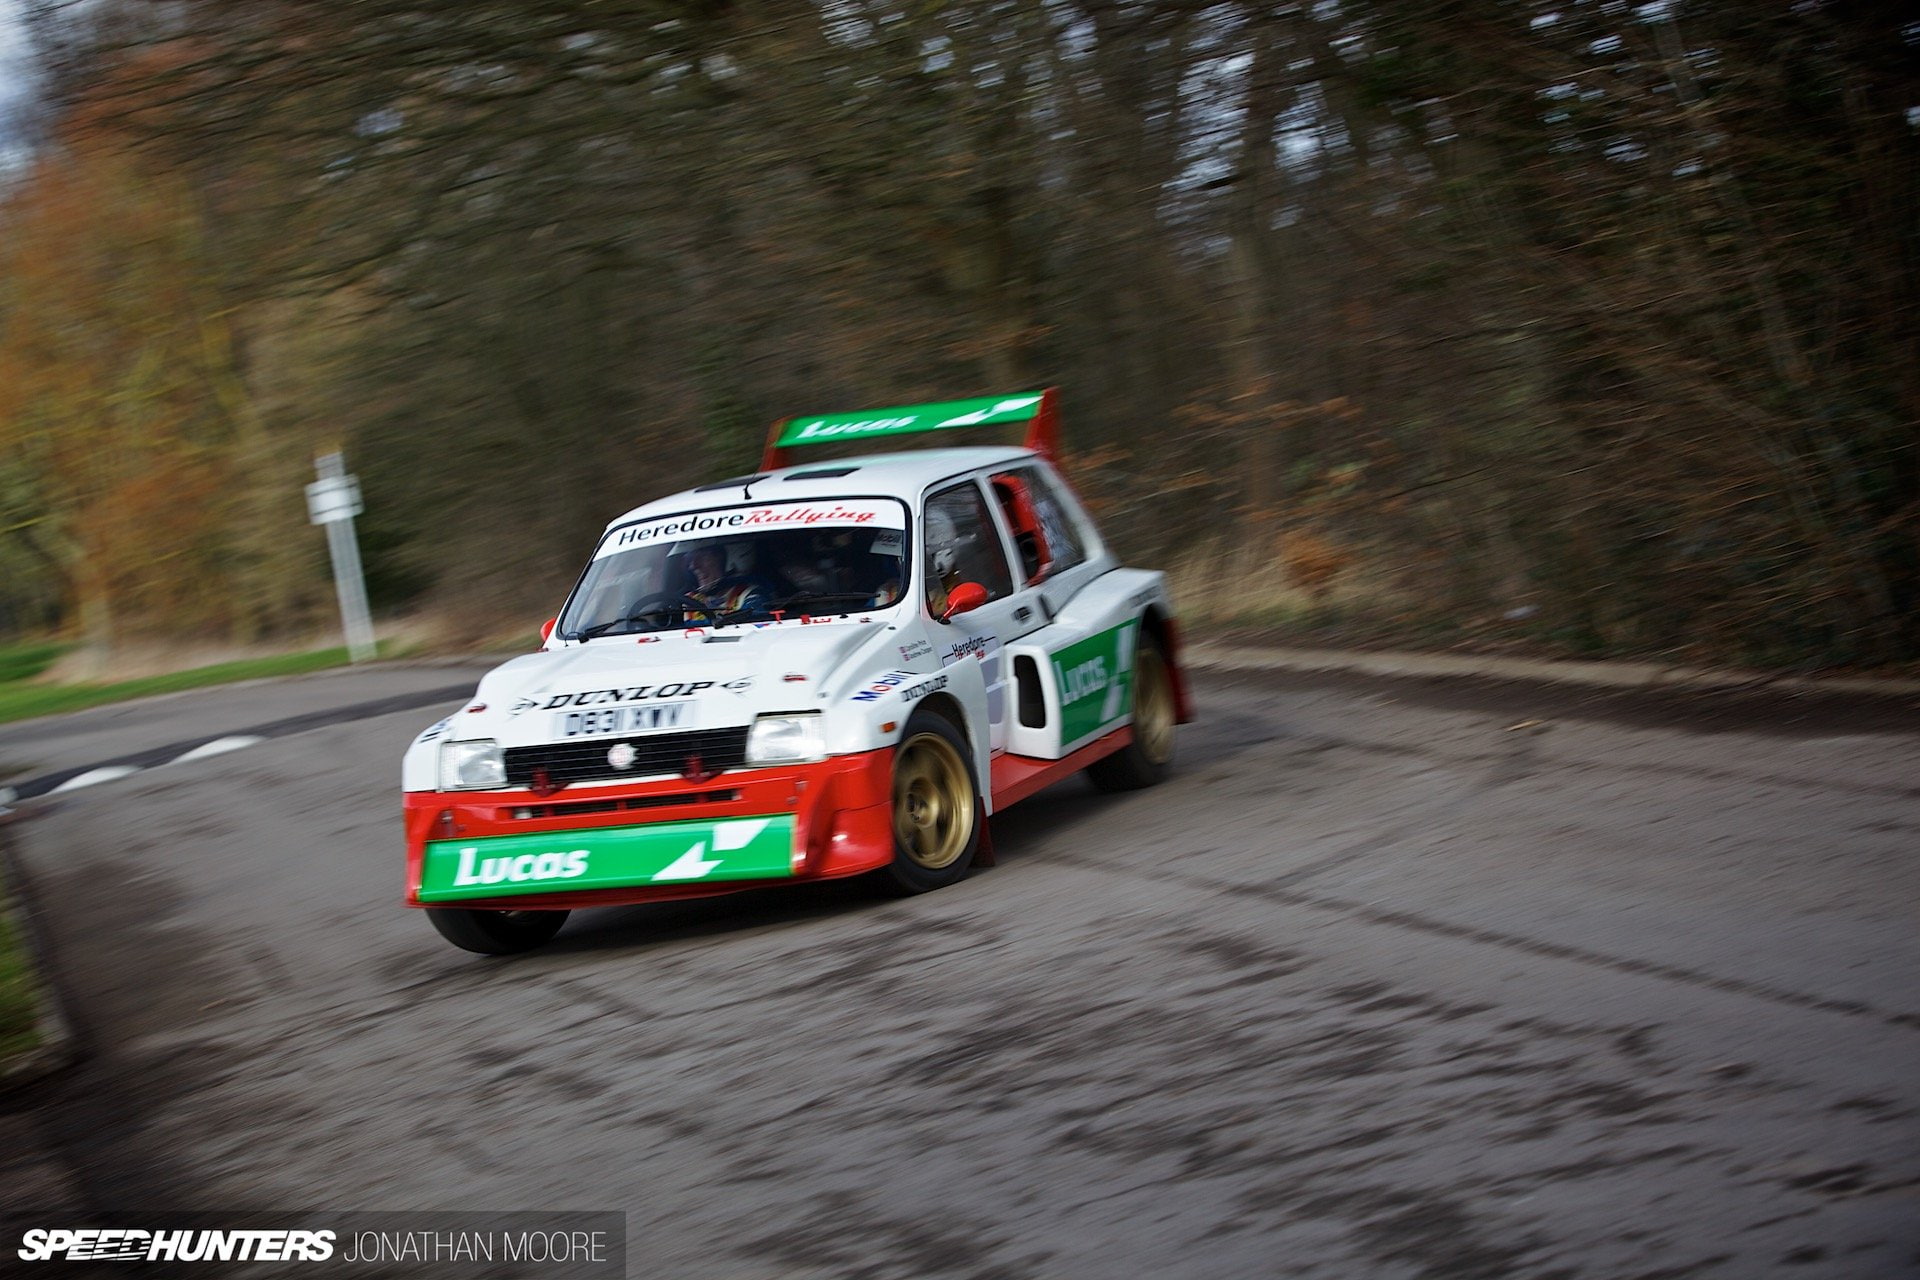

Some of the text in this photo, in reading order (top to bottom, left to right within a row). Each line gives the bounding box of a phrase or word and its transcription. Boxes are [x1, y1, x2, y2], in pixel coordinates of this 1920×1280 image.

[795, 415, 920, 440] Lucas
[542, 681, 717, 711] DUNLOP
[452, 847, 591, 887] Lucas
